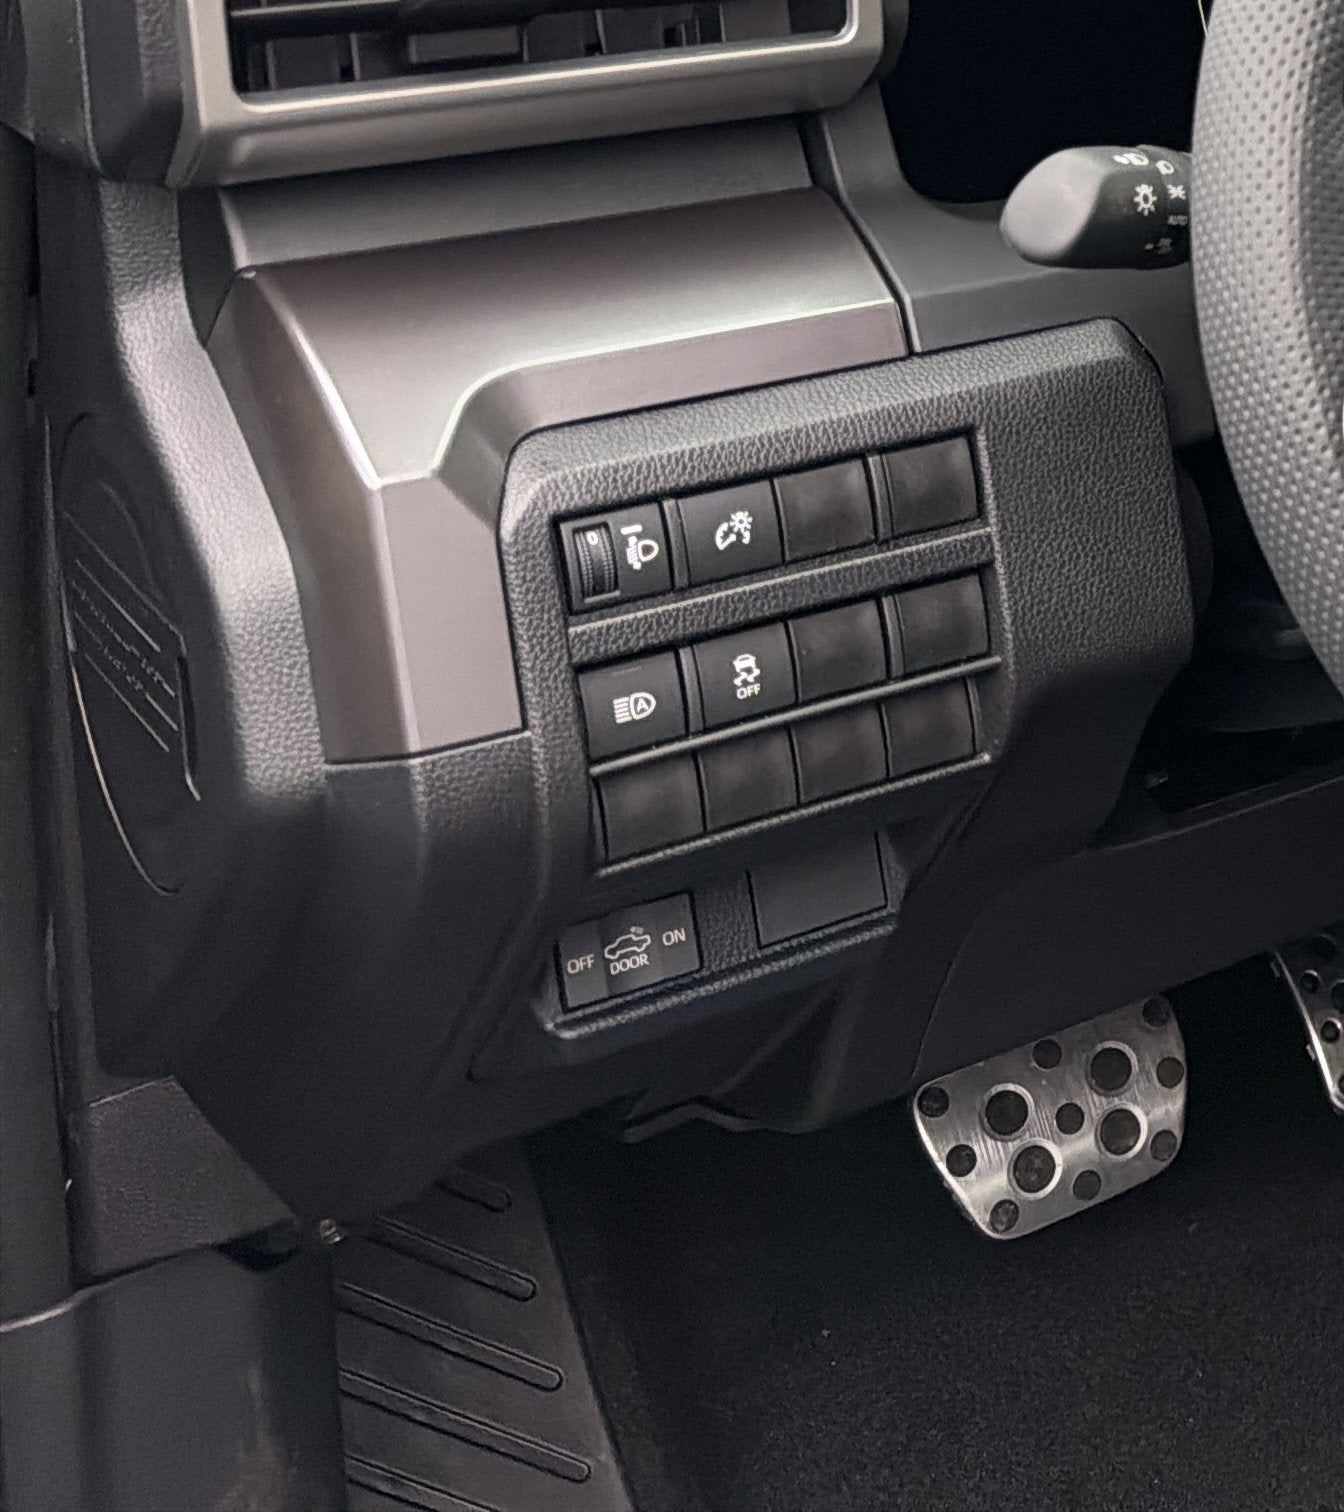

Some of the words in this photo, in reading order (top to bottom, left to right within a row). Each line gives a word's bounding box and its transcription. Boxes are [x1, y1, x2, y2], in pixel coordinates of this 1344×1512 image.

[1167, 214, 1189, 226] AUTO
[736, 682, 761, 700] OFF
[662, 928, 687, 947] ON
[566, 954, 595, 975] OFF
[609, 953, 650, 976] DOOR
